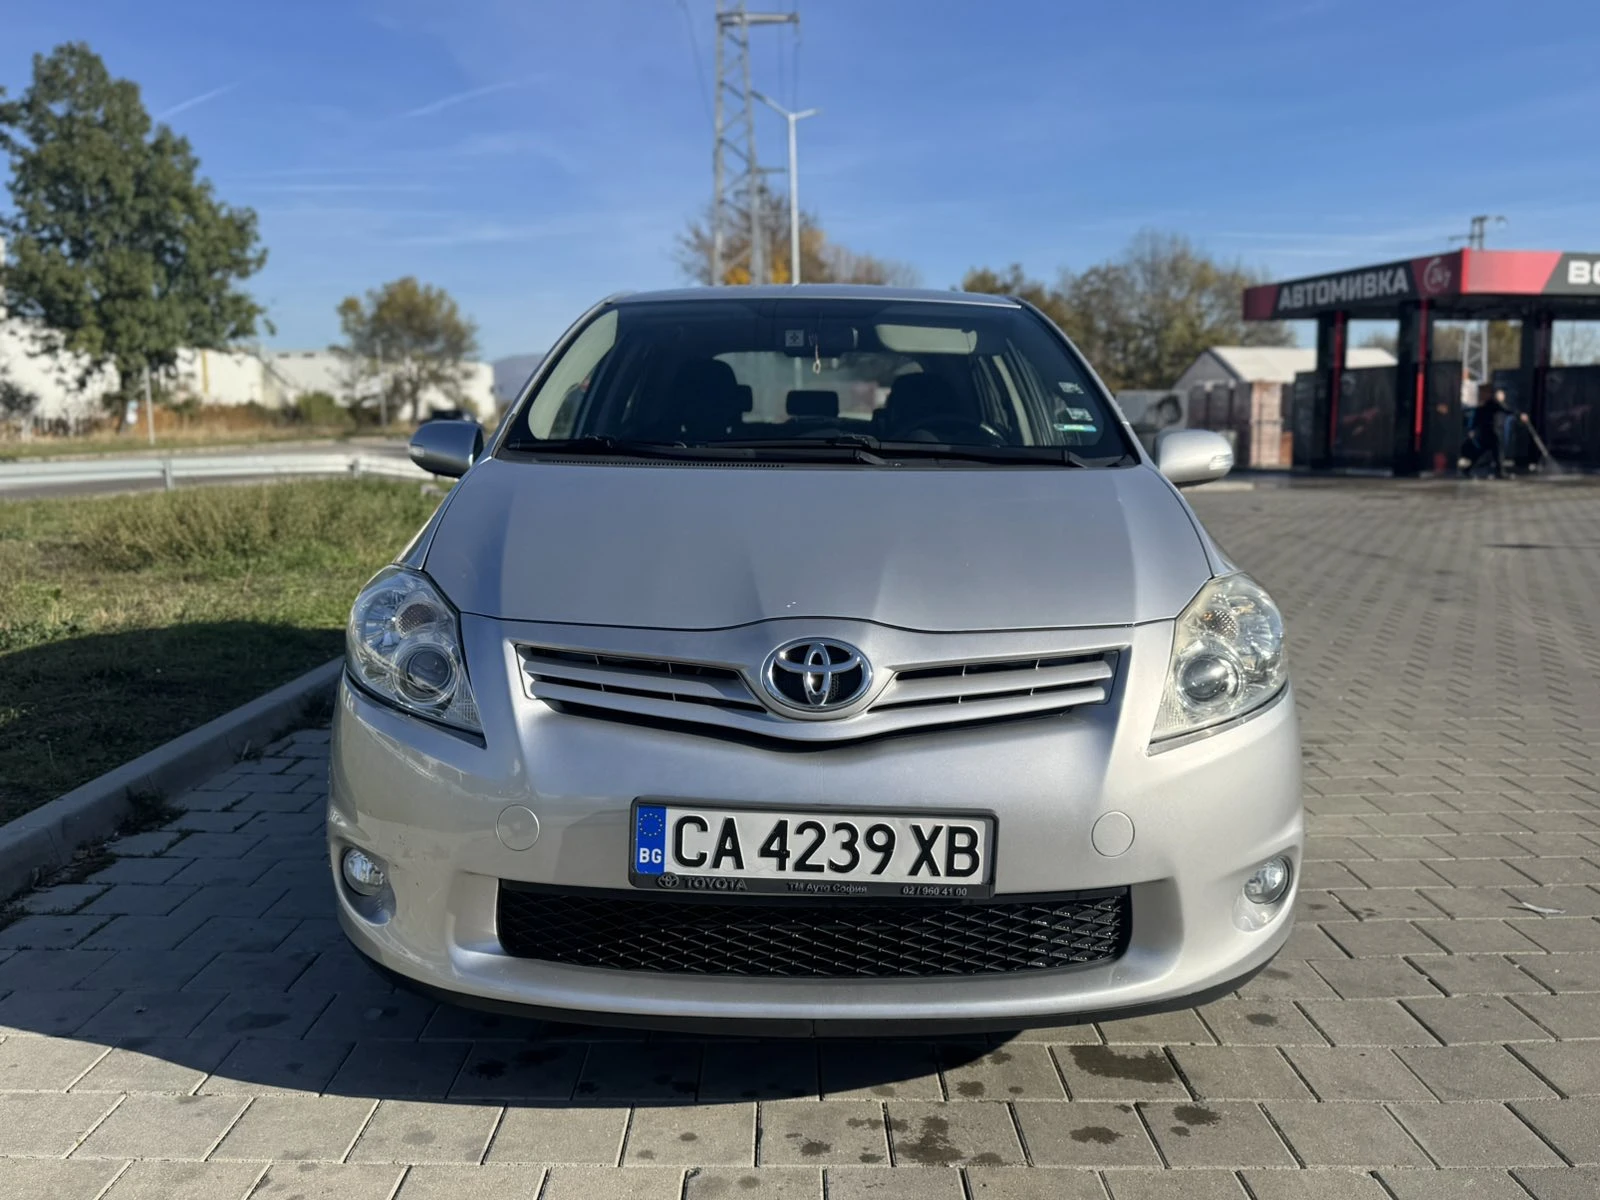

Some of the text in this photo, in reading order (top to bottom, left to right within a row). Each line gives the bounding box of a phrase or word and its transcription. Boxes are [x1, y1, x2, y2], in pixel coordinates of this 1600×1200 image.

[1278, 267, 1409, 310] АВТОМИВКА
[673, 815, 980, 878] CA 4239 XB
[638, 847, 663, 864] BG
[683, 876, 748, 891] TOYOTA
[832, 883, 868, 895] София
[902, 885, 915, 896] 02
[955, 887, 968, 897] 00
